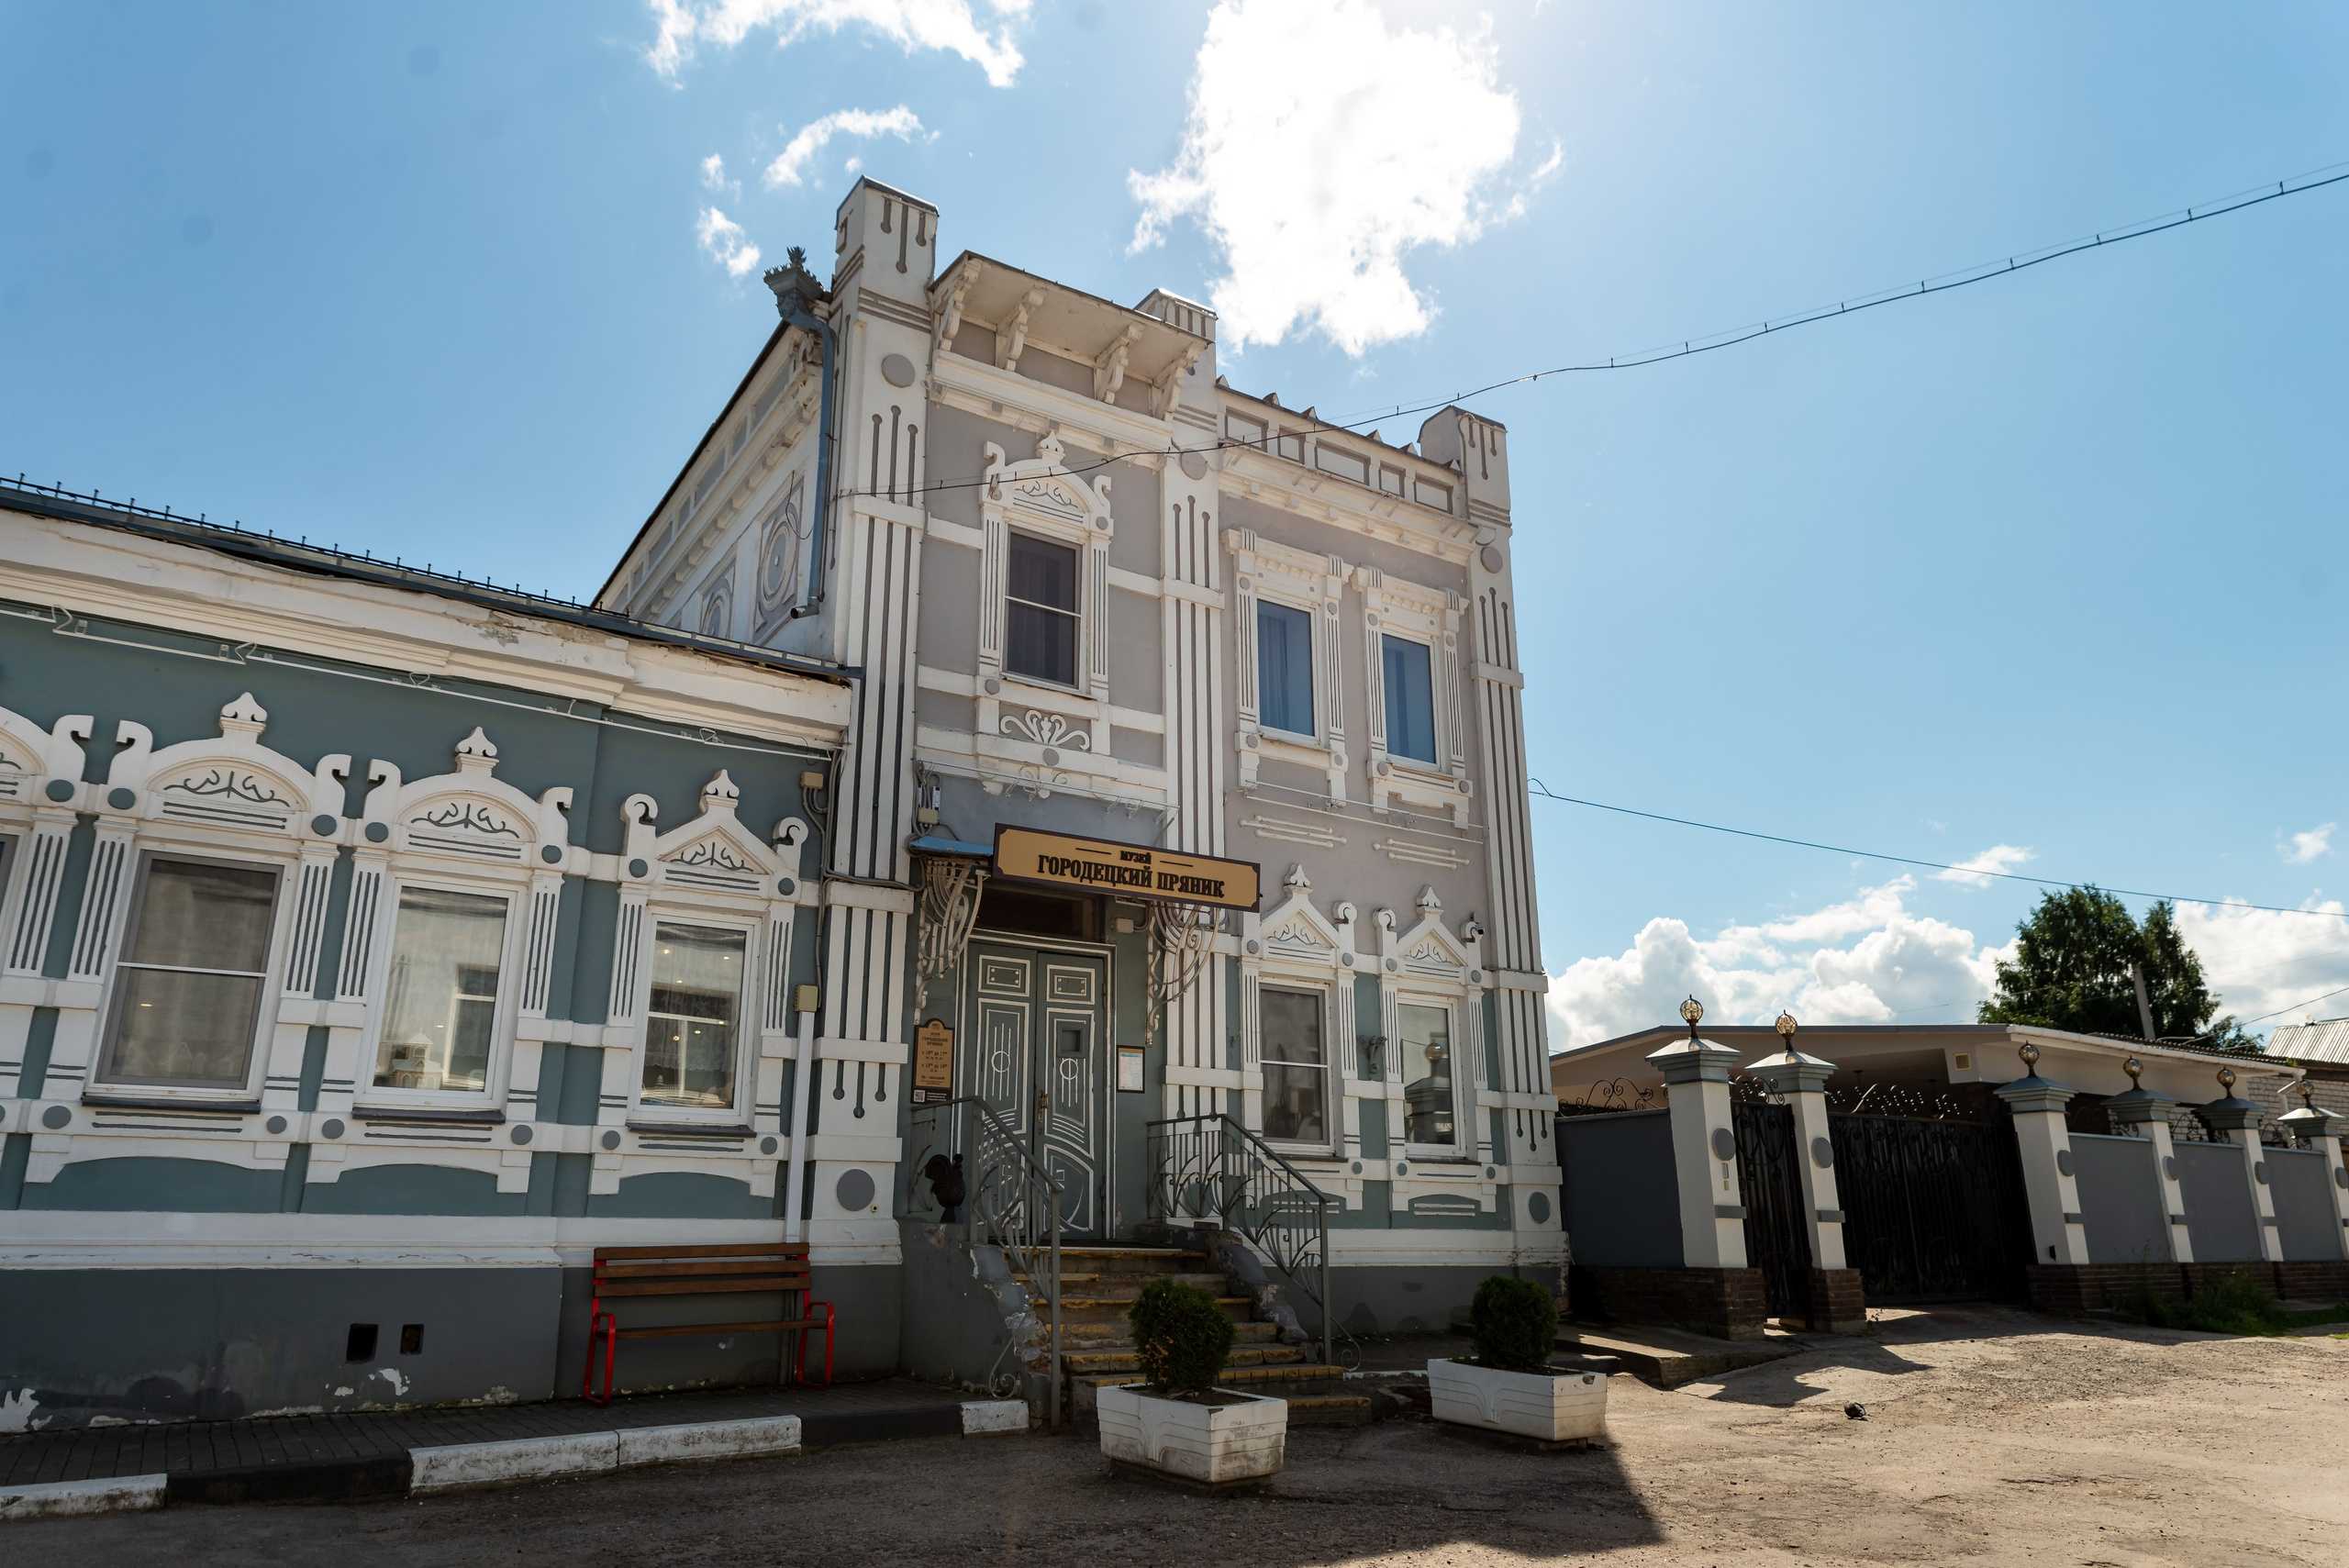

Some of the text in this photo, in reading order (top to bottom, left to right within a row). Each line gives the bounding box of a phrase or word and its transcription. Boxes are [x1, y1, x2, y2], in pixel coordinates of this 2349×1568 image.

[1119, 850, 1152, 865] МУЗЕЙ
[1037, 854, 1226, 898] ГОРОДЕЦКИЙ ПРЯНИК
